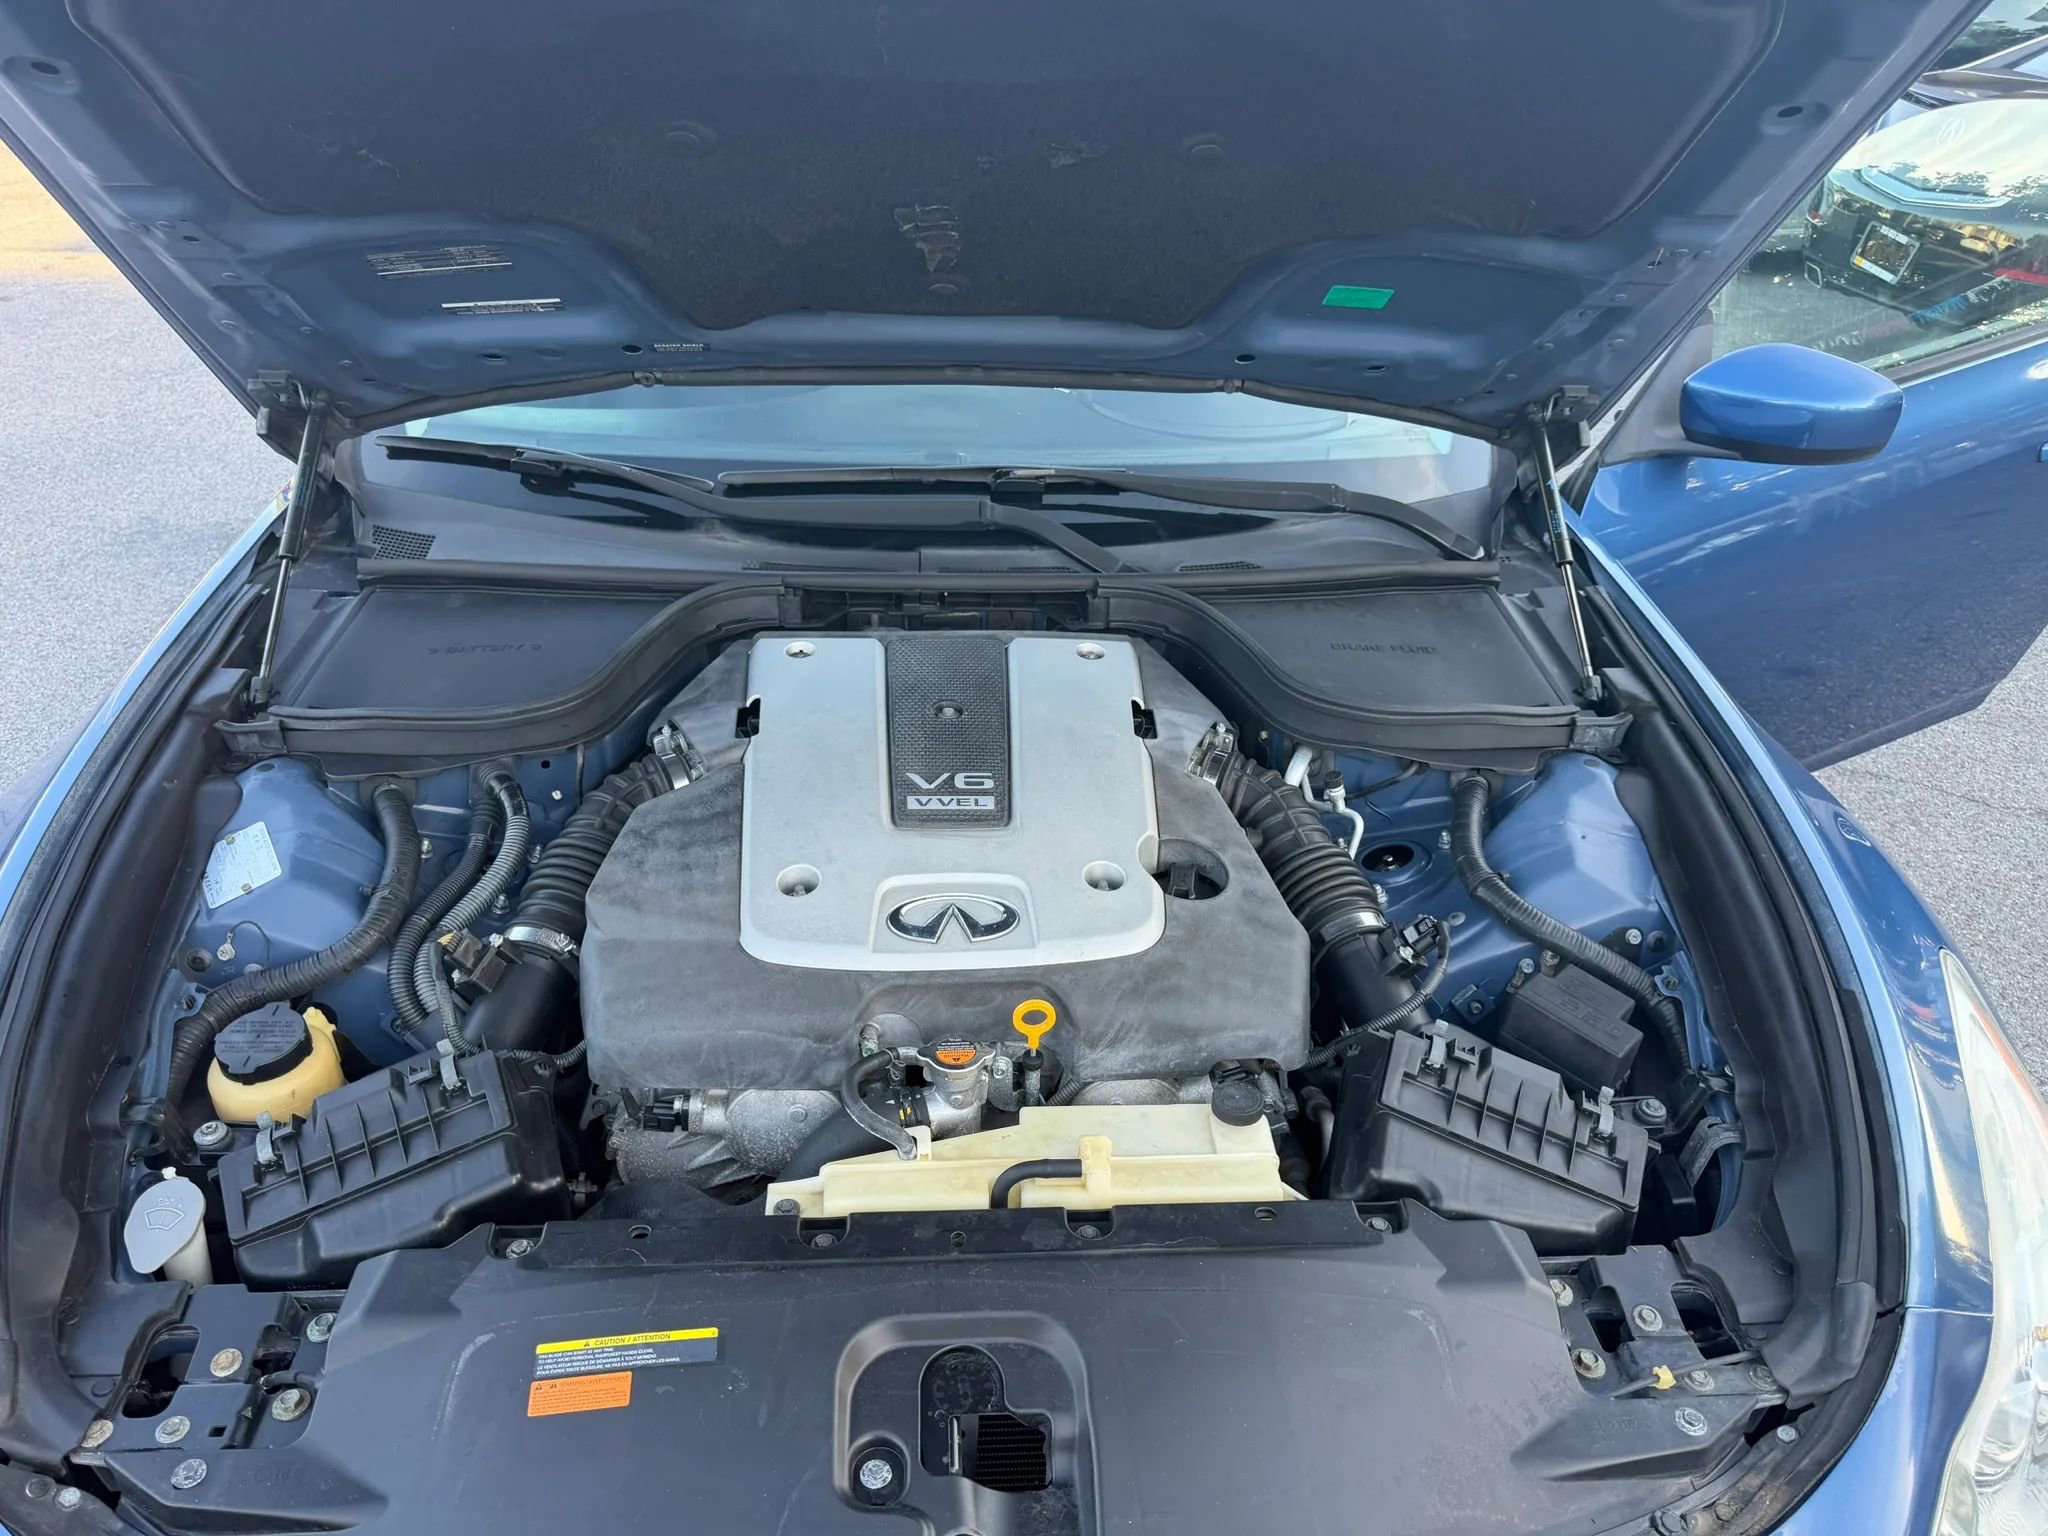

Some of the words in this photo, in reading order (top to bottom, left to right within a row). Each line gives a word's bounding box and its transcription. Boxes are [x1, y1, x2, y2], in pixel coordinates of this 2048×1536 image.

[906, 772, 994, 790] V6
[914, 798, 988, 807] VVEL
[595, 1338, 625, 1346] CAUTION
[633, 1334, 670, 1342] ATTENTION
